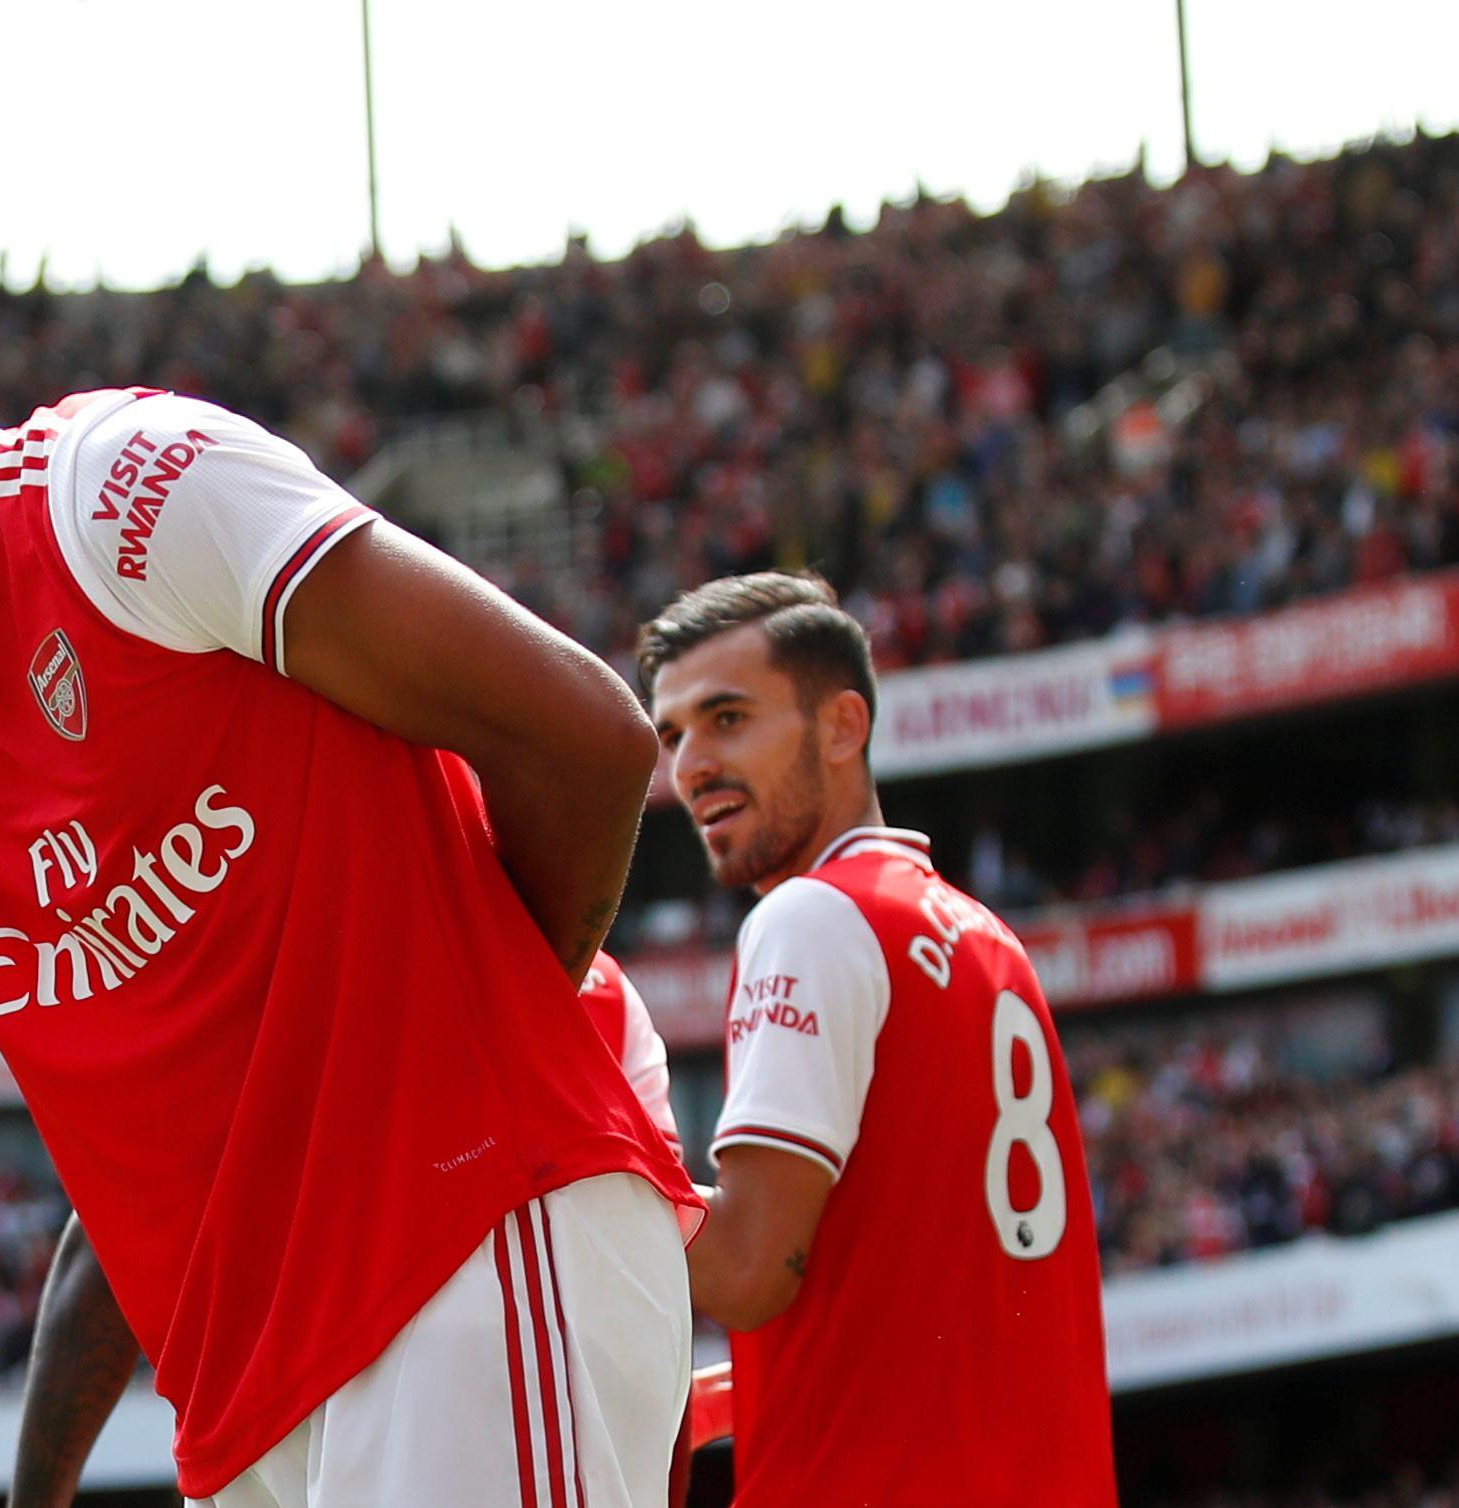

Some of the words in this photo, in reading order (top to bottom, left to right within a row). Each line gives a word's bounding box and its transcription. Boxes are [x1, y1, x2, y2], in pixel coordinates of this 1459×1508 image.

[92, 430, 158, 521] VISIT
[116, 429, 221, 582] RWANDA
[36, 643, 68, 695] Arsenal
[27, 820, 99, 909] Fly
[743, 972, 799, 1002] VISIT
[984, 988, 1068, 1262] 8
